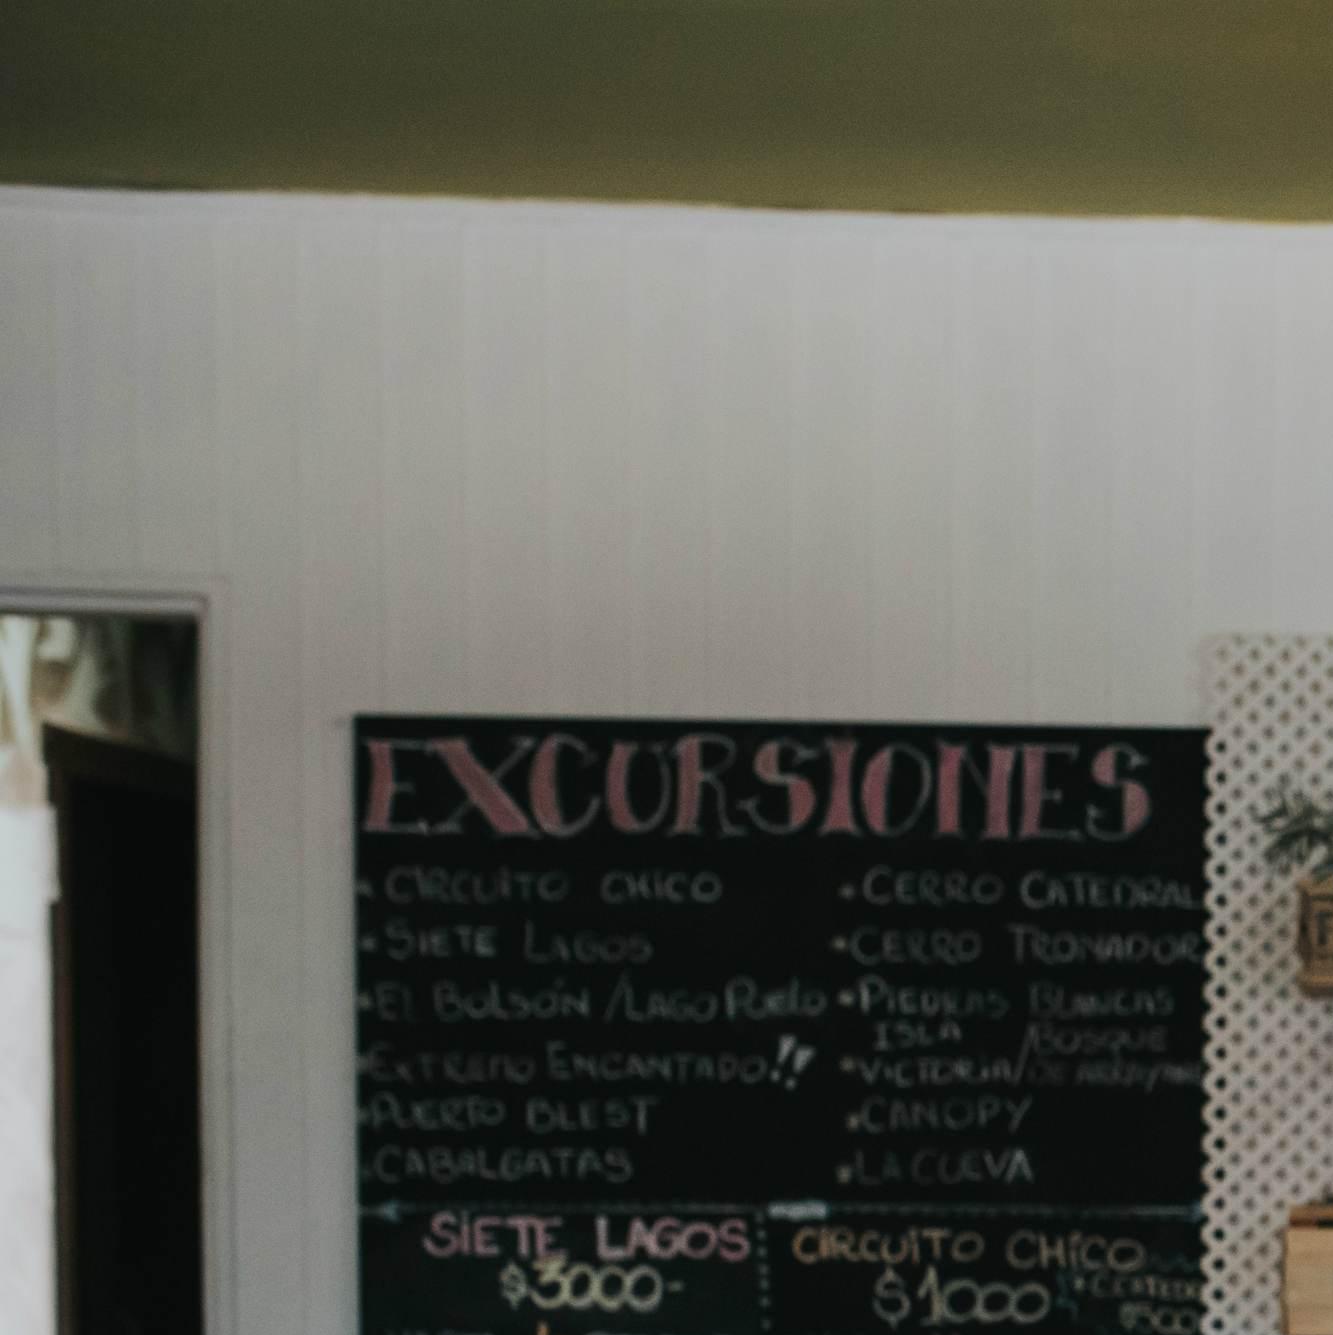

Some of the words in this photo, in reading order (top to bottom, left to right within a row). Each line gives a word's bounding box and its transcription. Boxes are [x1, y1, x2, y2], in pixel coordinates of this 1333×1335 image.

[362, 732, 1152, 842] EXCURSIONES
[384, 865, 570, 904] CIRCUITO
[862, 864, 1005, 906] CERRO
[383, 915, 498, 960] SIETE
[524, 919, 655, 964] LAGOS
[847, 924, 983, 966] CERRO
[861, 1094, 1033, 1135] CANOPY
[373, 1144, 635, 1185] CABALGATAS
[421, 1210, 564, 1260] SIETE
[594, 1214, 752, 1263] LAGOS
[791, 1226, 985, 1265] CIRCUITO
[1005, 1228, 1147, 1272] CHICO
[872, 1263, 1051, 1329] $1000
